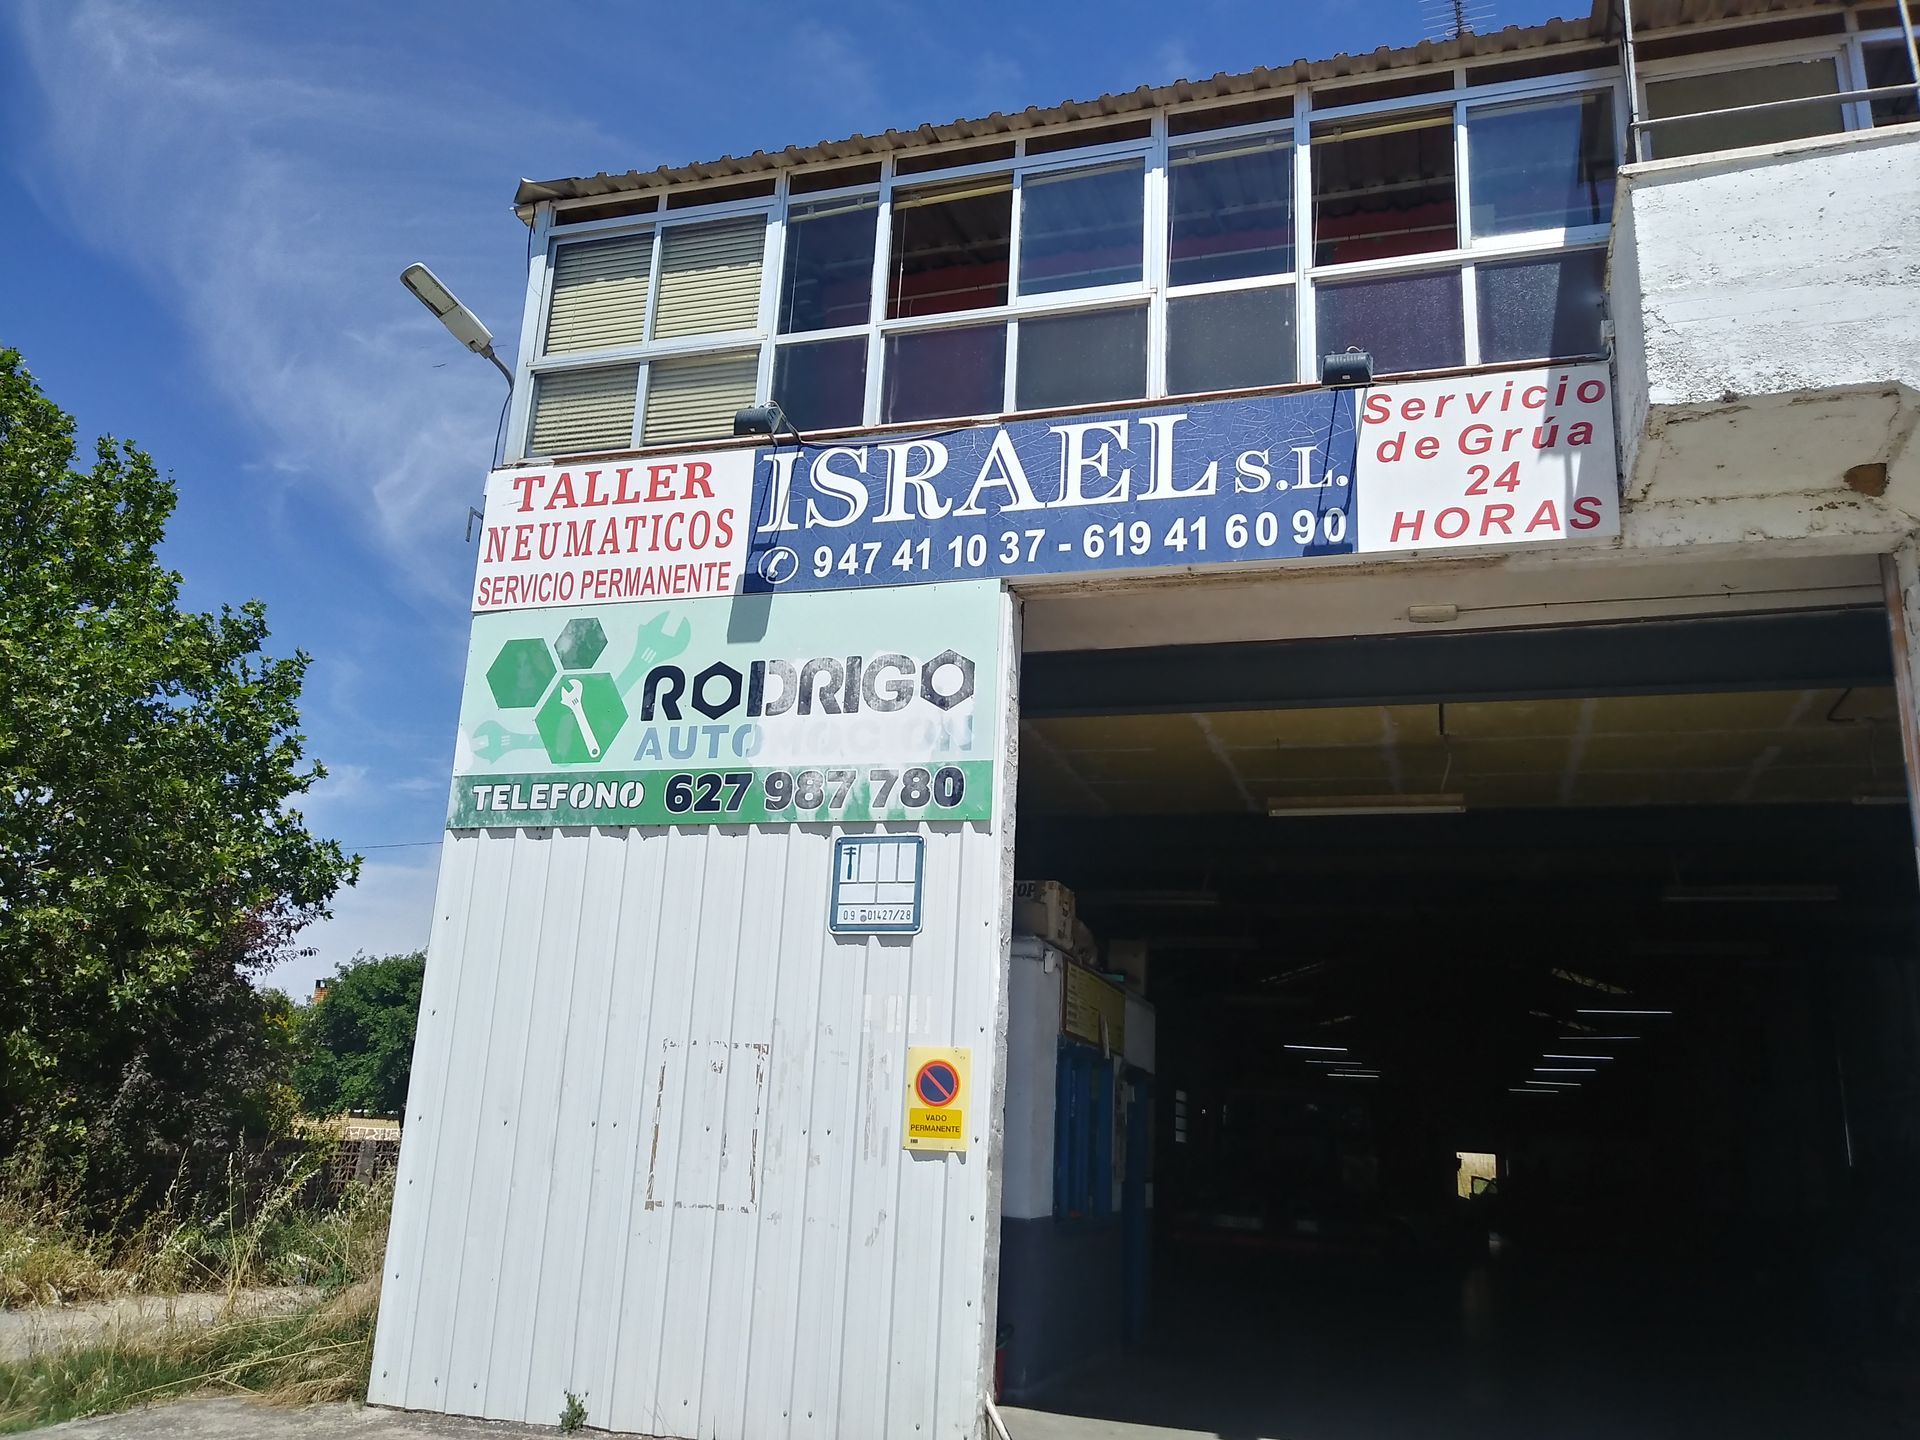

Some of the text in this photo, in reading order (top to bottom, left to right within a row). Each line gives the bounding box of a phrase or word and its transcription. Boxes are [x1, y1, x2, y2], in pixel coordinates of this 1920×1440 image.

[1362, 375, 1606, 424] Servicio
[1376, 416, 1594, 463] de Grúa
[513, 461, 715, 513] TALLER
[757, 413, 1349, 534] ISRAEL S.L.
[1464, 461, 1521, 496] 24
[484, 508, 734, 563] NEUMATICOS
[813, 543, 881, 578] 947
[892, 537, 931, 572] 41
[948, 534, 987, 568] 10
[999, 529, 1046, 563] 37
[1083, 521, 1152, 558] 619
[1163, 516, 1207, 552] 41
[1225, 512, 1279, 549] 60
[1292, 507, 1348, 544] 90
[1389, 496, 1602, 543] HORAS
[477, 561, 731, 606] SERVICIO PERMANENTE
[640, 648, 976, 722] RODRIGO
[472, 766, 966, 814] TELEFONO 627 987 780
[910, 1124, 961, 1133] PERMANENTE
[925, 1114, 948, 1122] VADO
